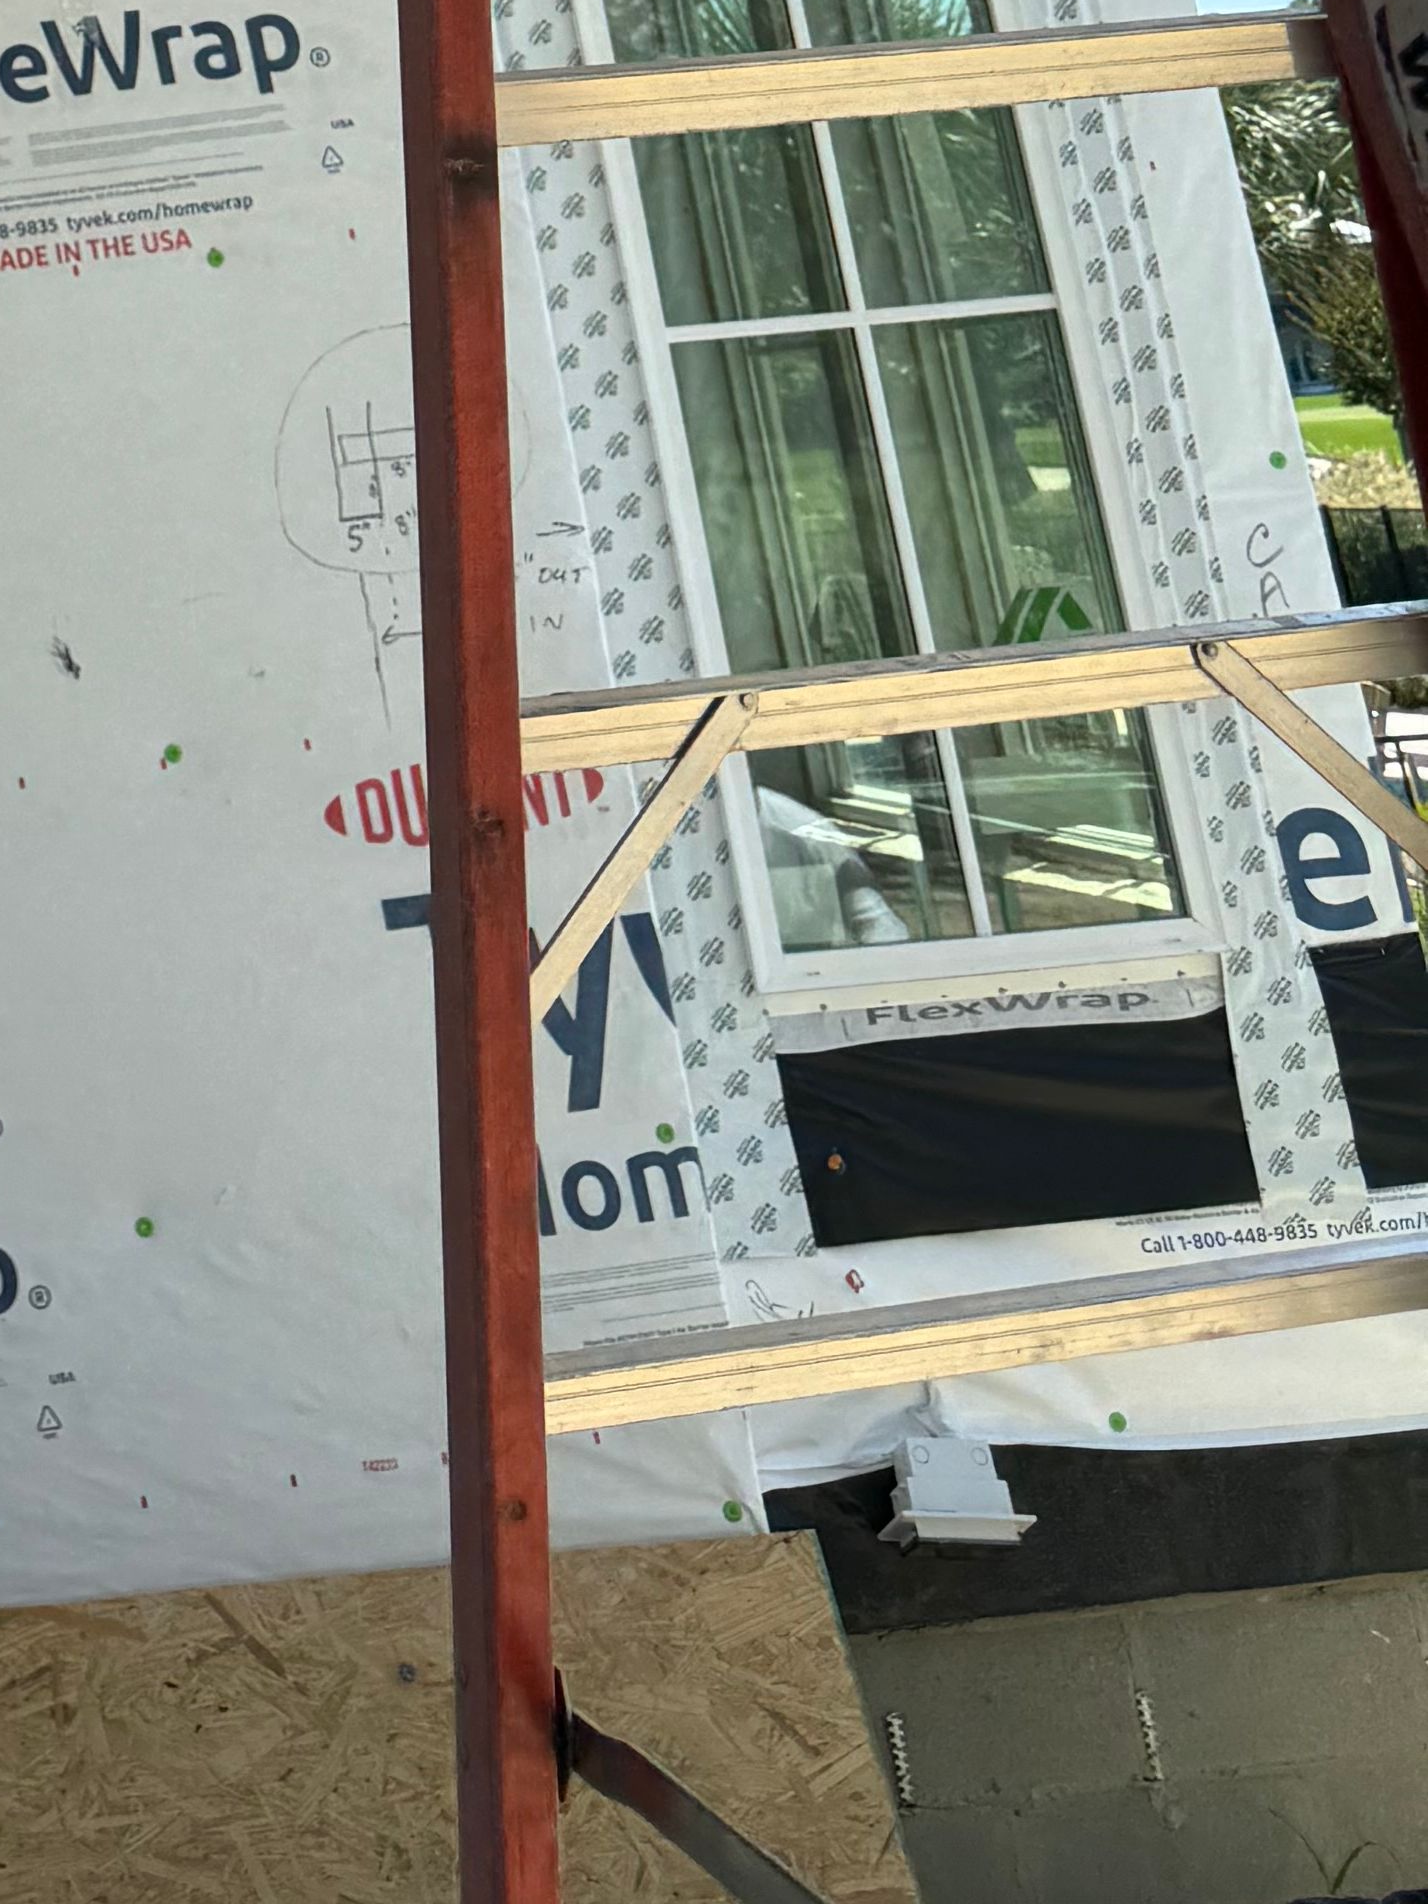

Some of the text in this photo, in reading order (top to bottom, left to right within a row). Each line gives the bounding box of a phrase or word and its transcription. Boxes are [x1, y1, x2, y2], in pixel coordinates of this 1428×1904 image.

[66, 194, 253, 231] tyvek.com/homewrap
[56, 243, 80, 265] IN
[86, 234, 135, 259] THE
[142, 229, 192, 252] USA
[530, 615, 563, 631] IN
[866, 990, 1151, 1027] FlexWrap
[1141, 1211, 1428, 1253] Call 1-800-448-9835 tyvek.com/h
